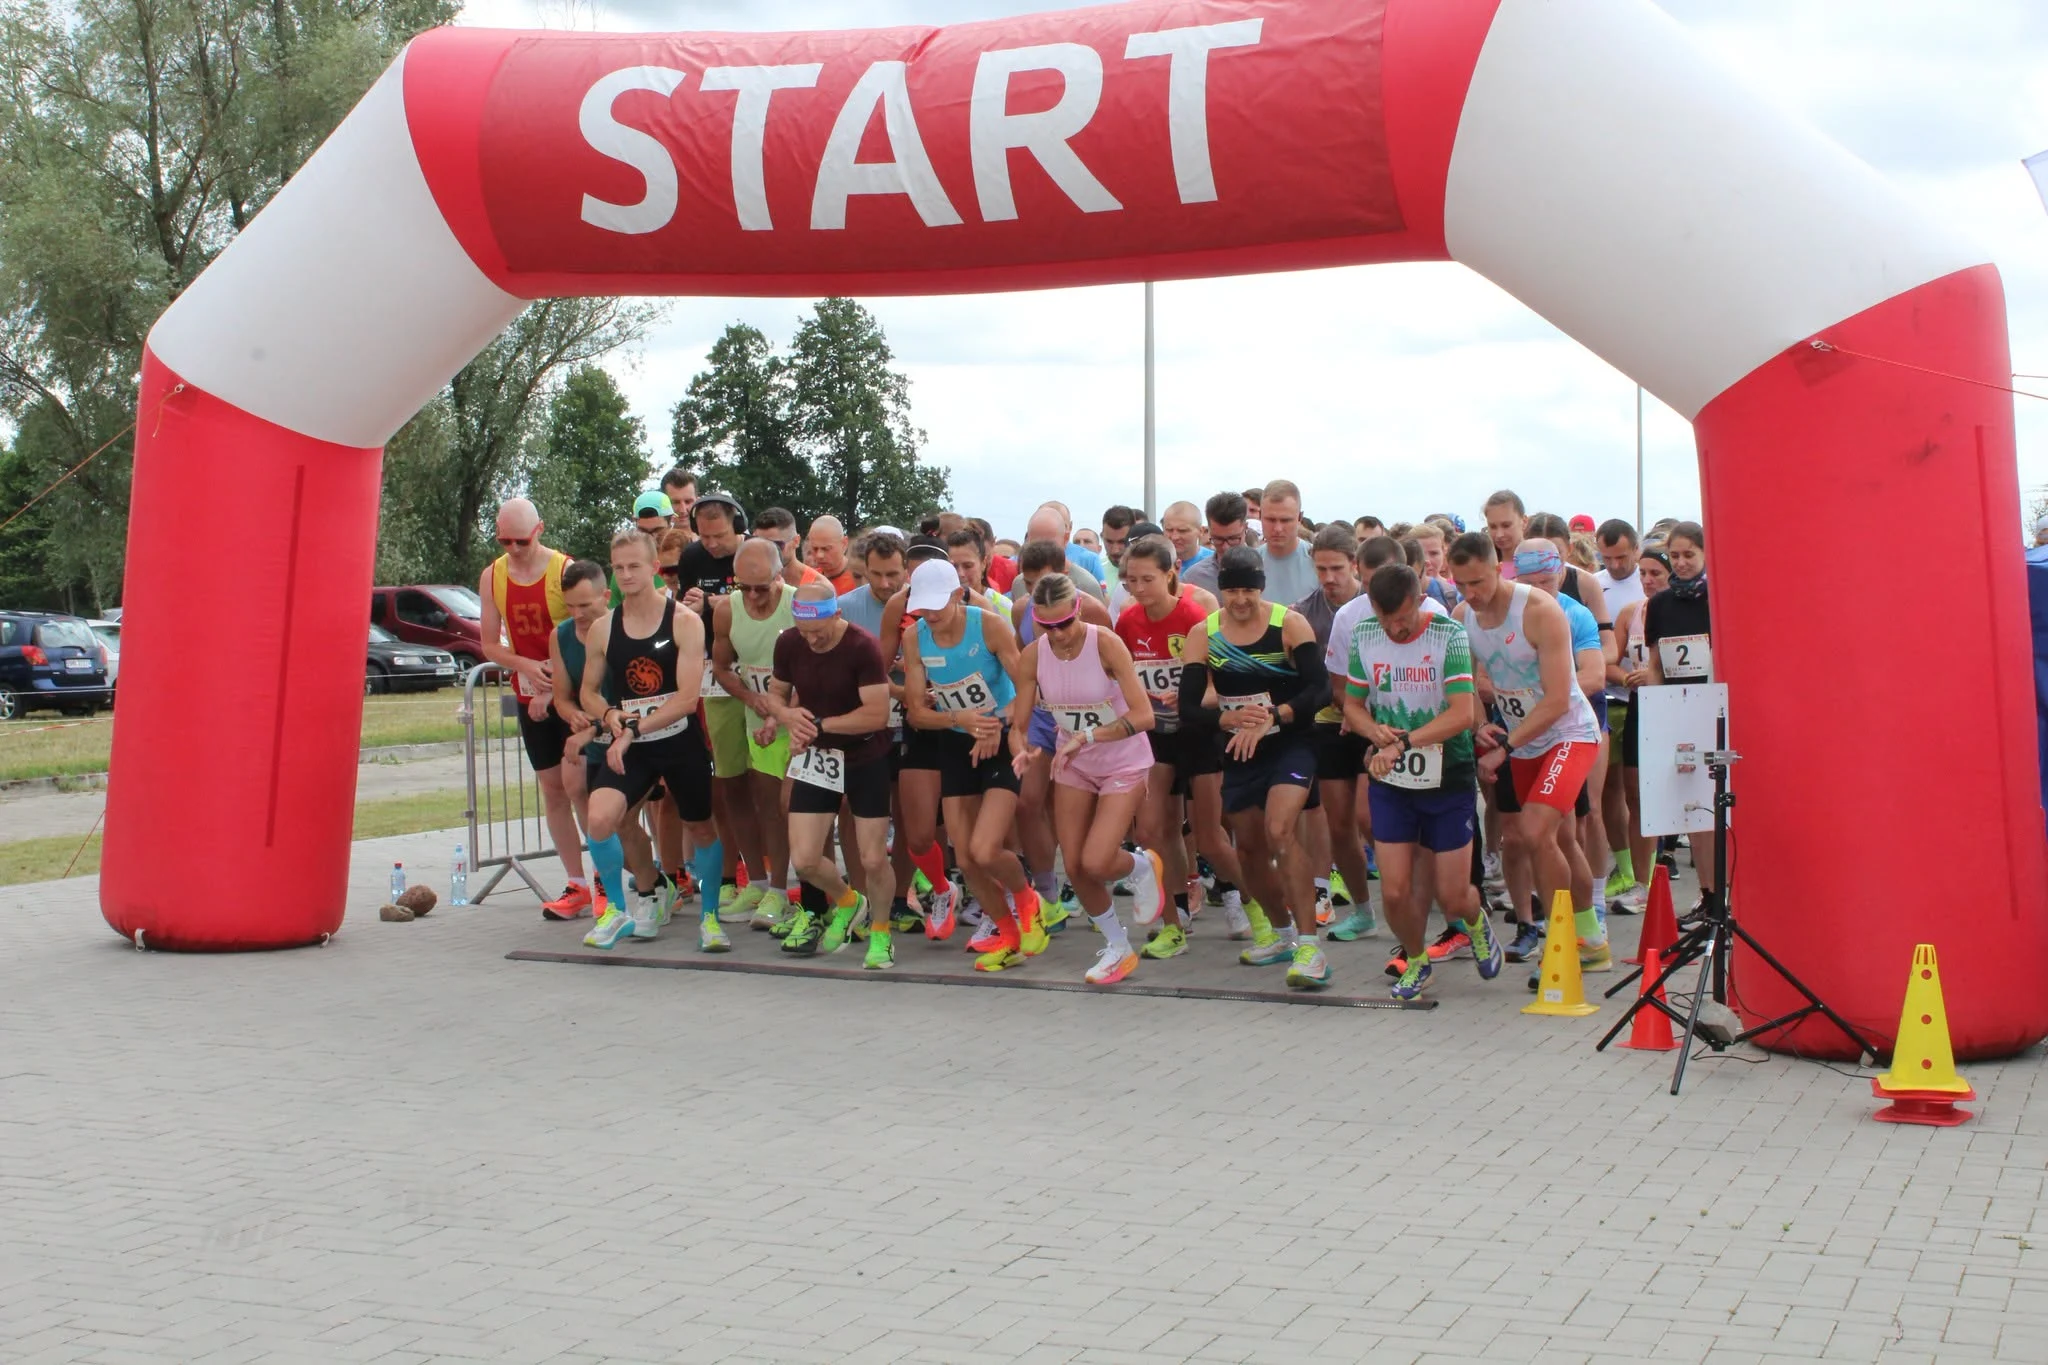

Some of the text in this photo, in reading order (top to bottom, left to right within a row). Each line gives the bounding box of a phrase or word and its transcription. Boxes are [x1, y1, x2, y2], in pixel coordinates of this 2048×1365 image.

[579, 17, 1264, 234] START
[512, 603, 544, 635] 53
[1676, 644, 1690, 666] 2
[1138, 666, 1183, 690] 165
[1393, 667, 1436, 682] JURUND
[938, 683, 986, 709] 118
[1065, 712, 1102, 731] 78
[802, 748, 840, 779] 133
[1540, 741, 1572, 795] POLSKA
